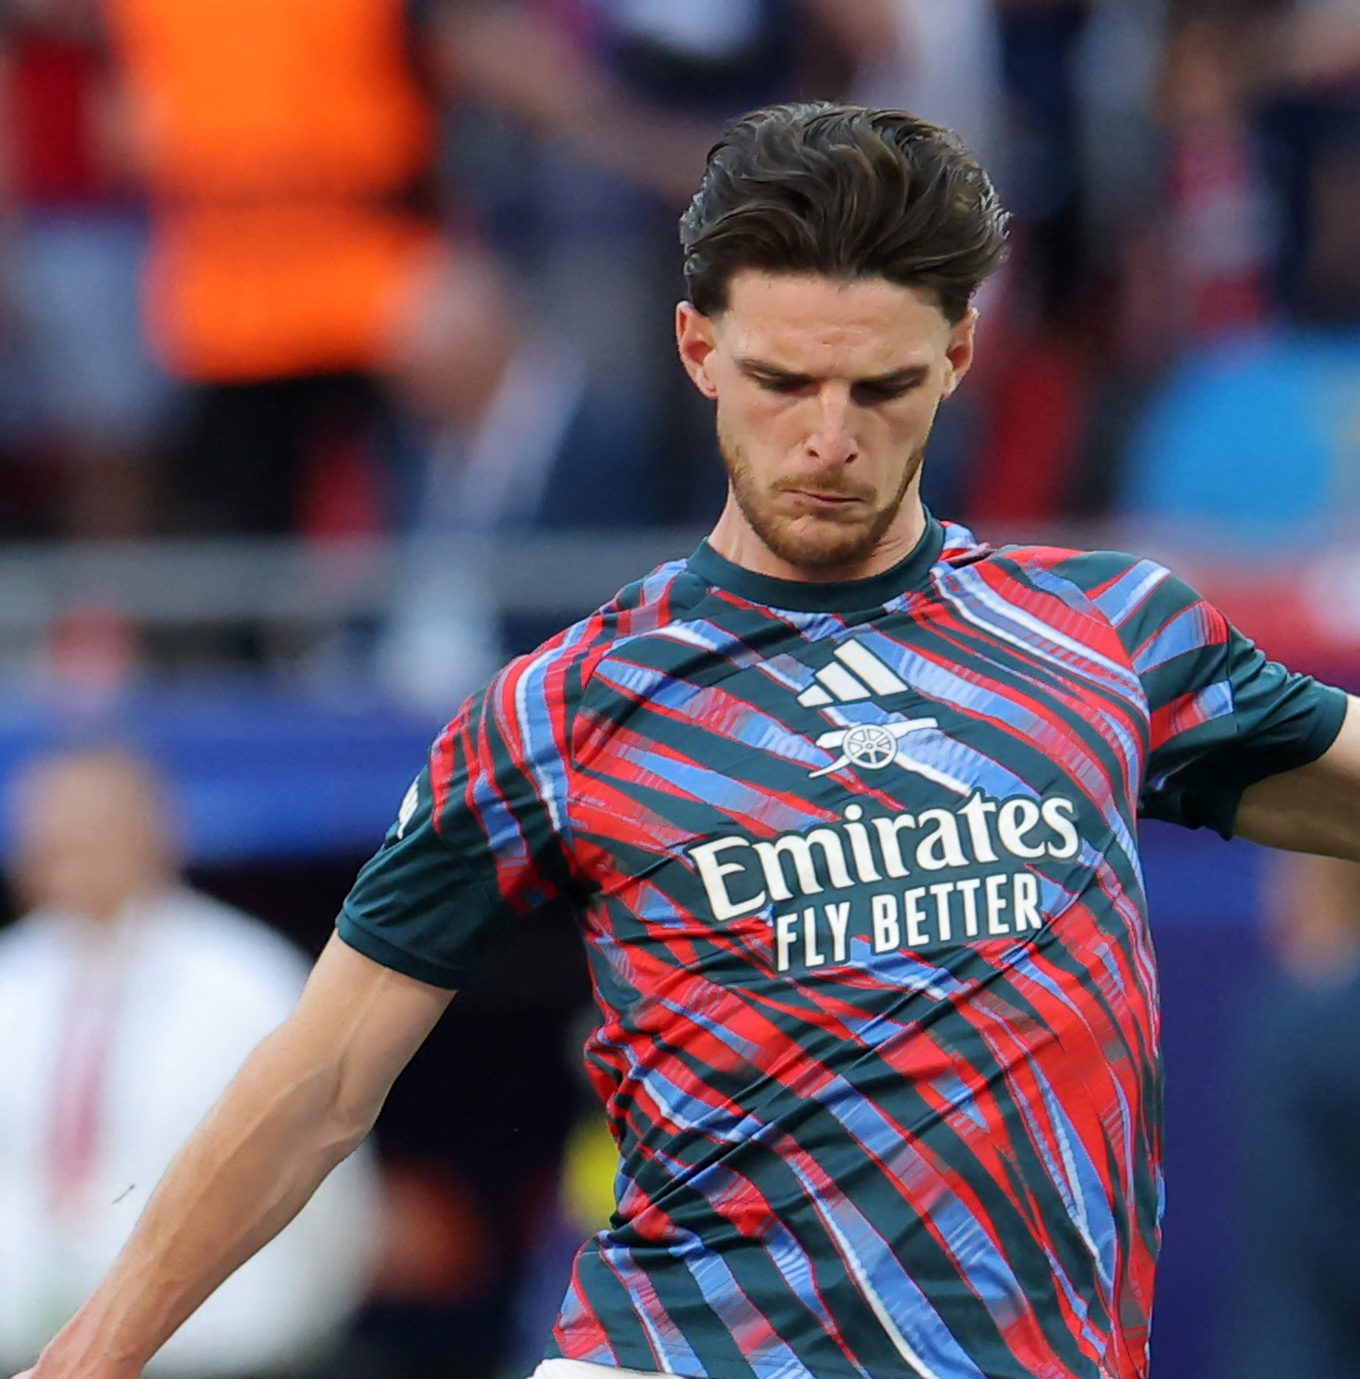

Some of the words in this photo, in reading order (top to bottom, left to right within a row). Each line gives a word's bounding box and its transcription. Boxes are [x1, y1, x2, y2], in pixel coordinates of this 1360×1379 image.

[687, 791, 1079, 922] Emirates
[776, 901, 851, 972] FLY
[870, 872, 1042, 954] BETTER
